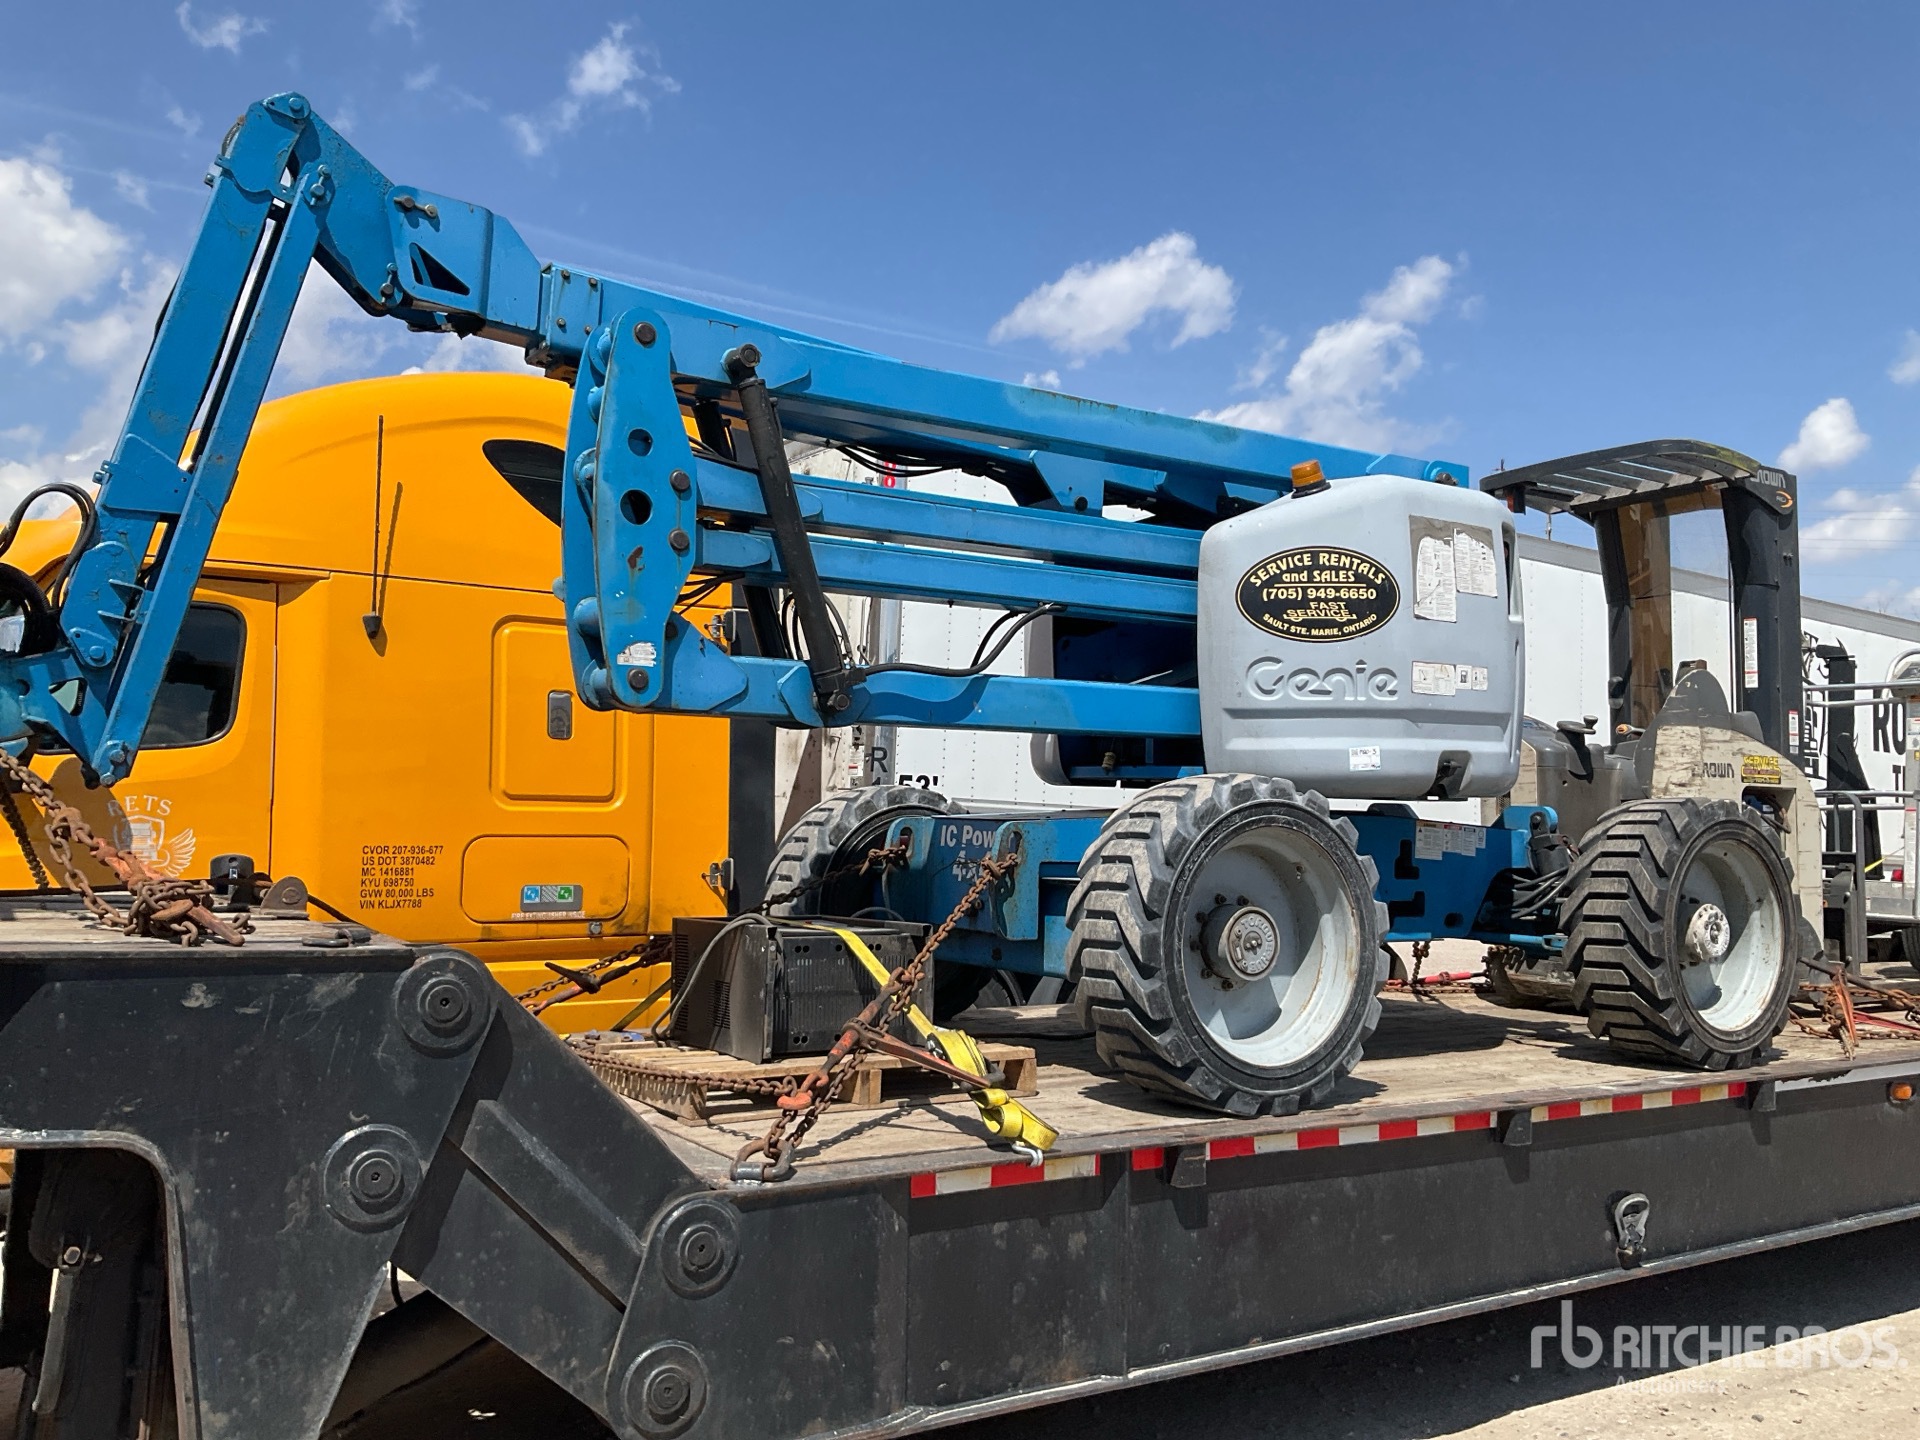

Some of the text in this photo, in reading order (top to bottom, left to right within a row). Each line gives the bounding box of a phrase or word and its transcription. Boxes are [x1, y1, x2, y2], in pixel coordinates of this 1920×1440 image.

[1249, 553, 1313, 587] SERVICE
[1319, 552, 1386, 585] RENTALS
[1282, 570, 1355, 583] and SALES
[1262, 587, 1377, 601] (705) 949-6650
[1309, 601, 1347, 610] FAST
[1286, 609, 1351, 617] SERVICE
[1262, 613, 1378, 636] SAULT STE. MARIE, ONTARIO
[1247, 656, 1399, 701] Genie
[940, 824, 958, 848] IC
[362, 845, 444, 855] CVOR 207-936-677
[362, 856, 436, 866] US DOT 3870482
[361, 867, 376, 877] MC
[360, 878, 415, 888] KYU 698750
[360, 888, 435, 899] GVW 80,000 LBS
[359, 900, 375, 909] VIN
